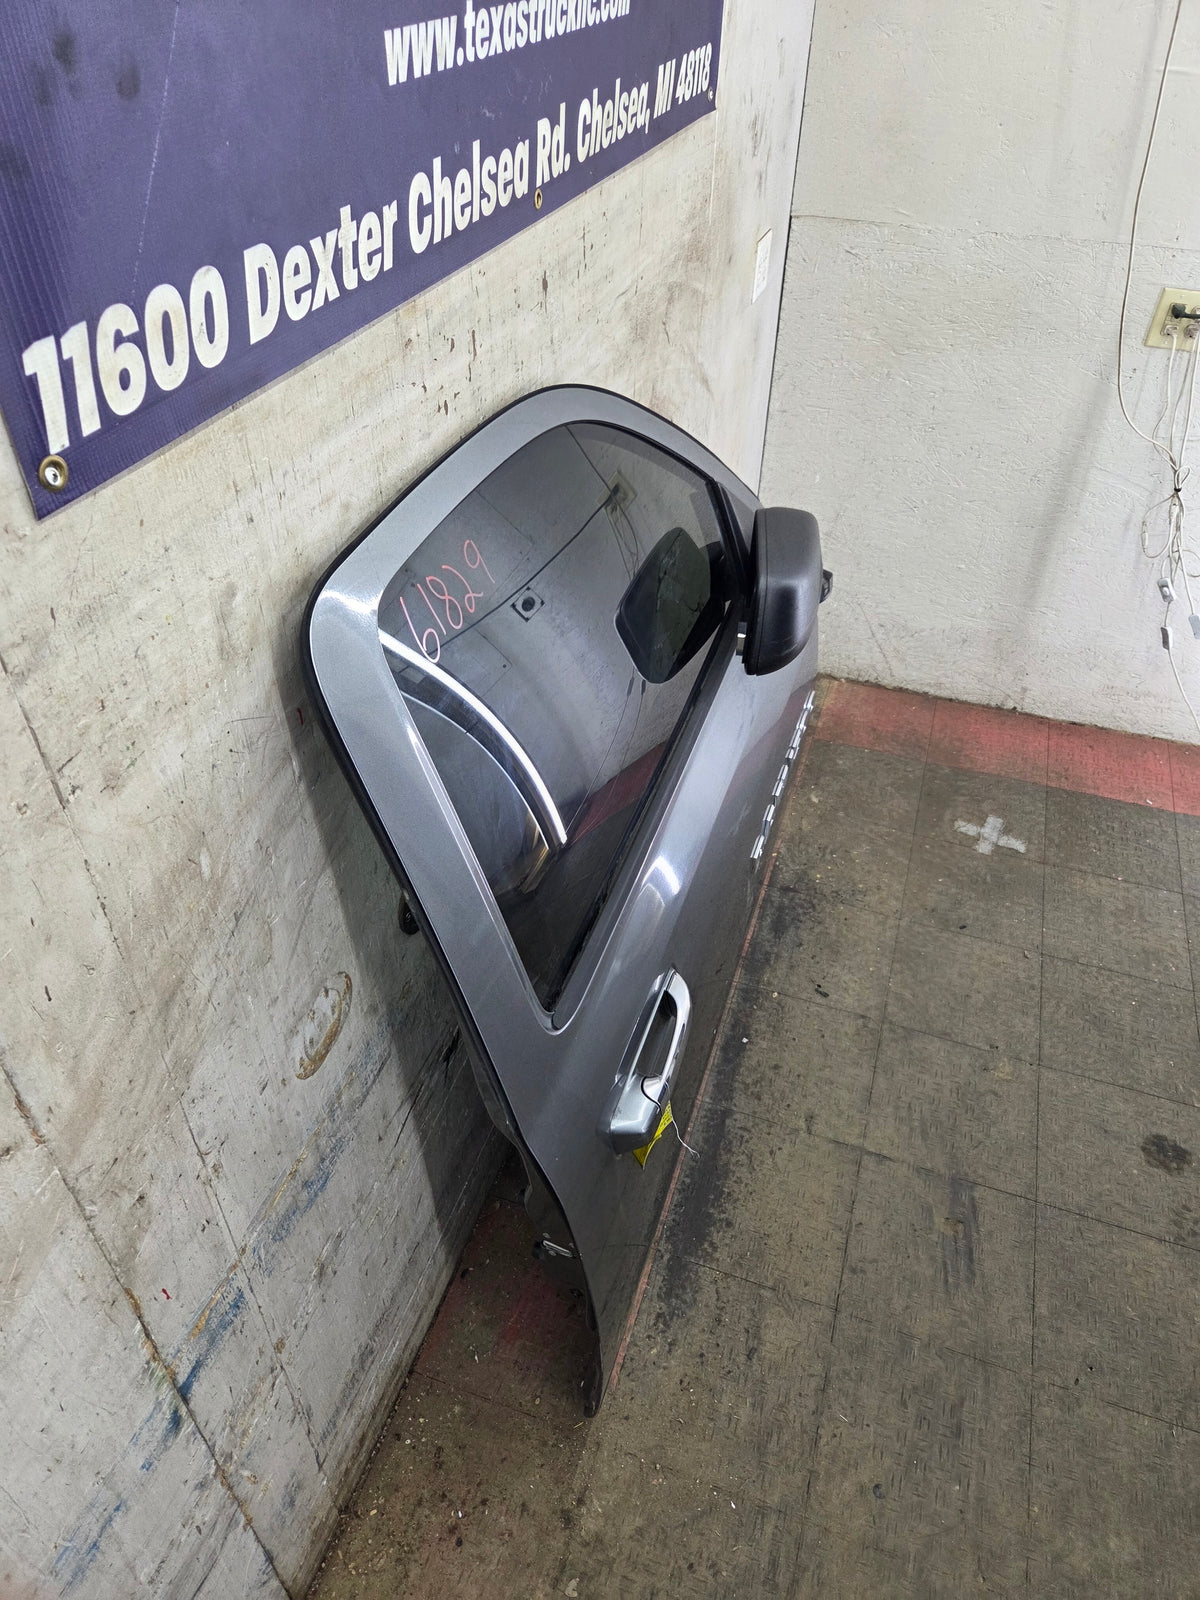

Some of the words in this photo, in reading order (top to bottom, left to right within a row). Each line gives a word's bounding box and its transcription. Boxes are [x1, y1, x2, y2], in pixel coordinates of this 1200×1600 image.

[22, 266, 229, 469] 11600
[244, 200, 397, 346] Dexter
[408, 139, 530, 254] Chelsea
[536, 102, 571, 189] Rd.
[577, 78, 650, 163] Chelsea,
[653, 59, 677, 119] MI
[675, 42, 712, 105] 48118
[400, 539, 496, 663] 61829
